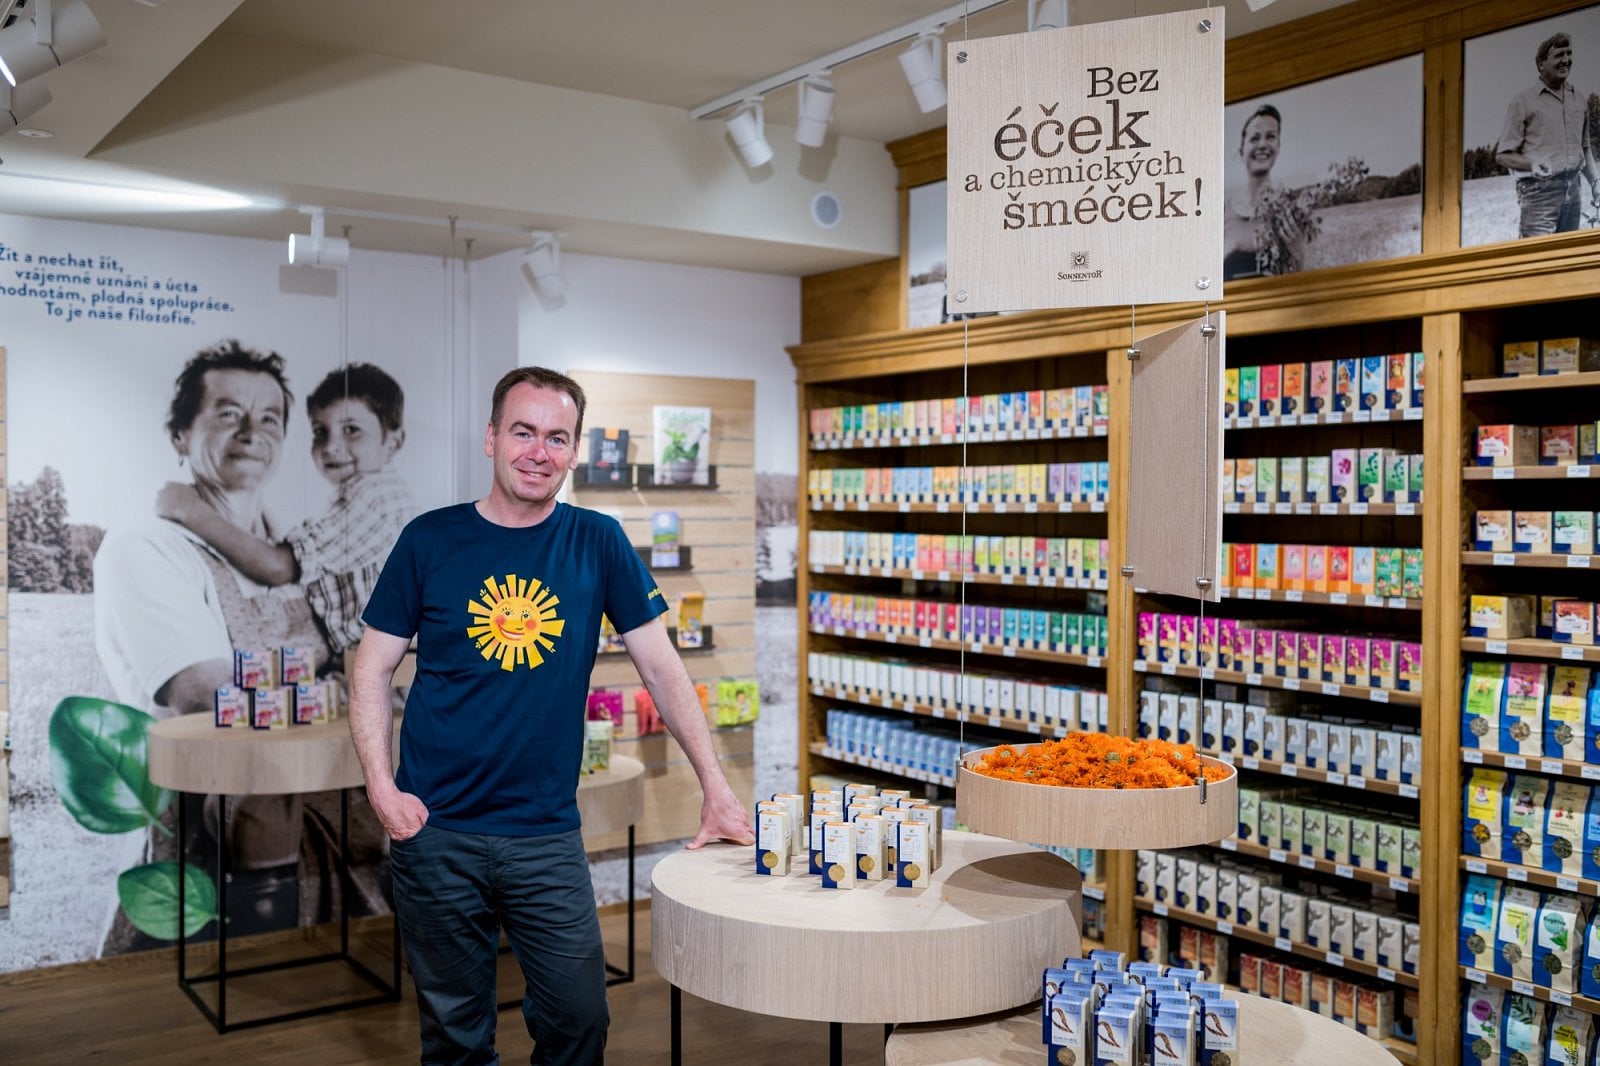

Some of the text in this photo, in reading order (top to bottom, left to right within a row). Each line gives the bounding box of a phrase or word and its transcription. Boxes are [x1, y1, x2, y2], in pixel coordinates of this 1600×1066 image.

[1087, 67, 1159, 98] Bez
[994, 99, 1151, 161] éček
[964, 150, 1185, 192] a chemických
[25, 253, 33, 264] a
[39, 252, 93, 268] nechat
[99, 256, 124, 273] žít,
[15, 267, 198, 293] vzájemné uznání a úcta
[45, 301, 196, 325] To je naše filozofie.
[91, 290, 144, 306] plodná
[149, 296, 235, 314] spolupráce.
